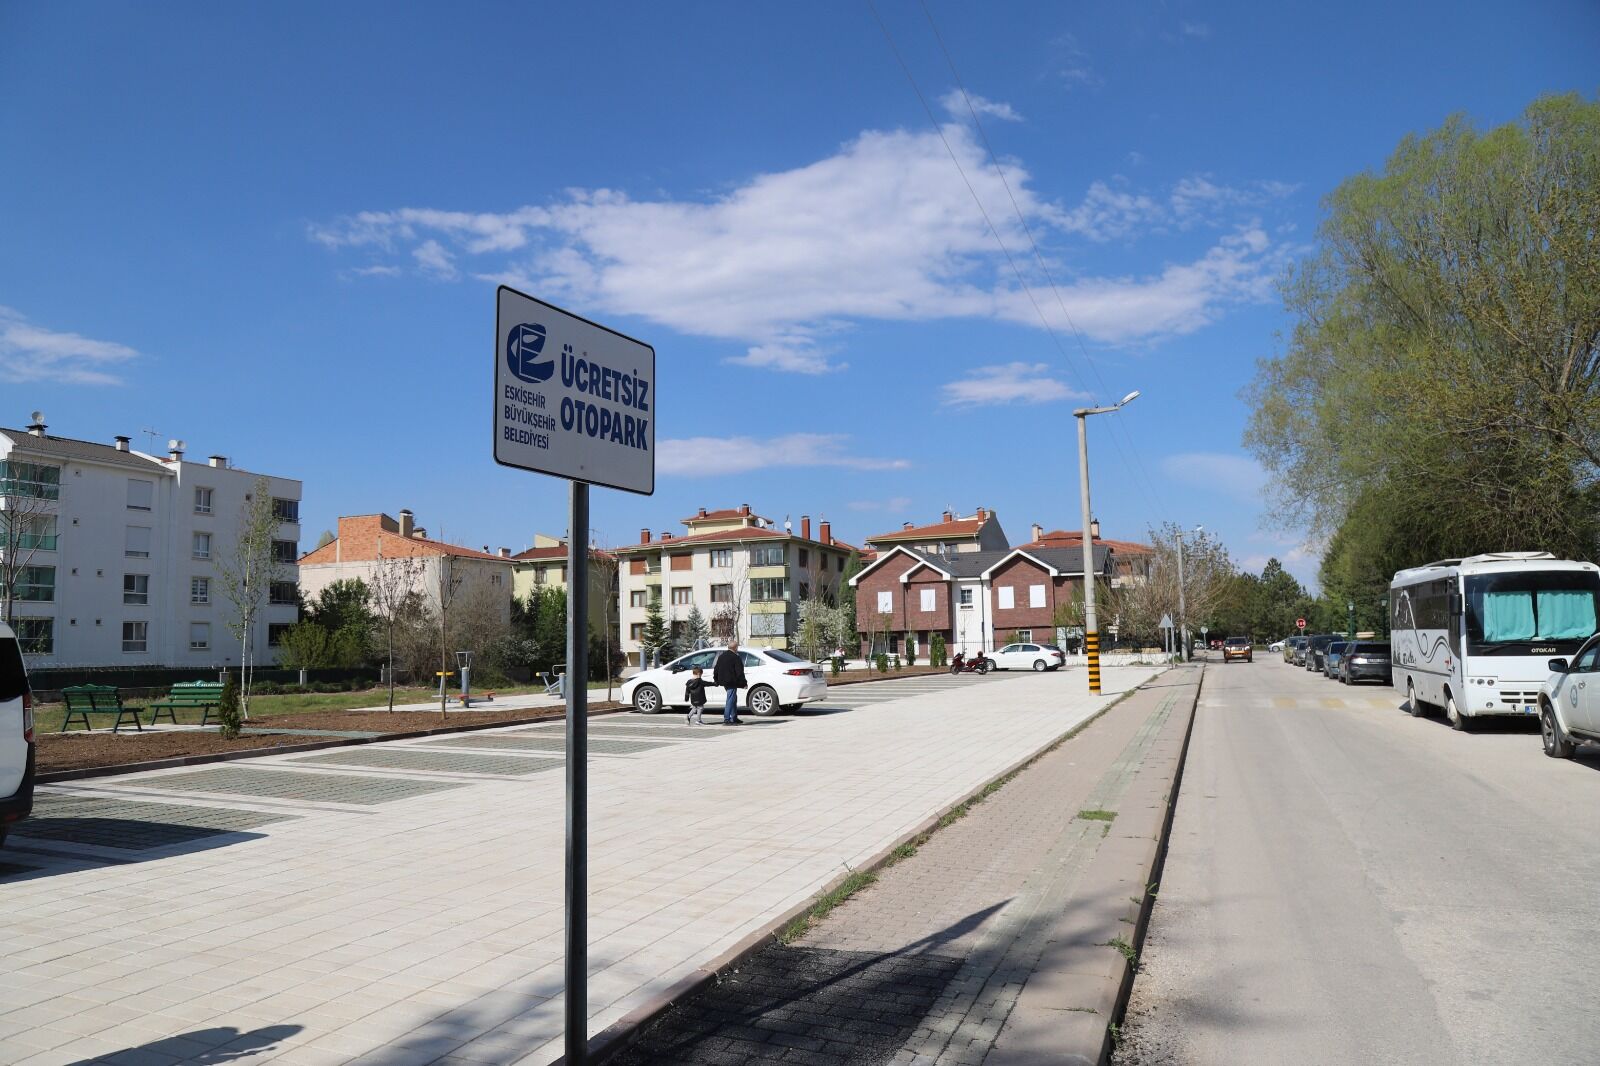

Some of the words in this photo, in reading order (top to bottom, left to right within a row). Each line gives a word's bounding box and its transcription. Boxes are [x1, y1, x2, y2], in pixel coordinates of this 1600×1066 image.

[561, 343, 649, 412] ÜCRETSİZ
[504, 384, 546, 410] ESKİŞEHİR
[504, 404, 556, 432] BÜYÜKŞEHİR
[560, 396, 648, 451] OTOPARK
[504, 425, 549, 450] BELEDİYESİ
